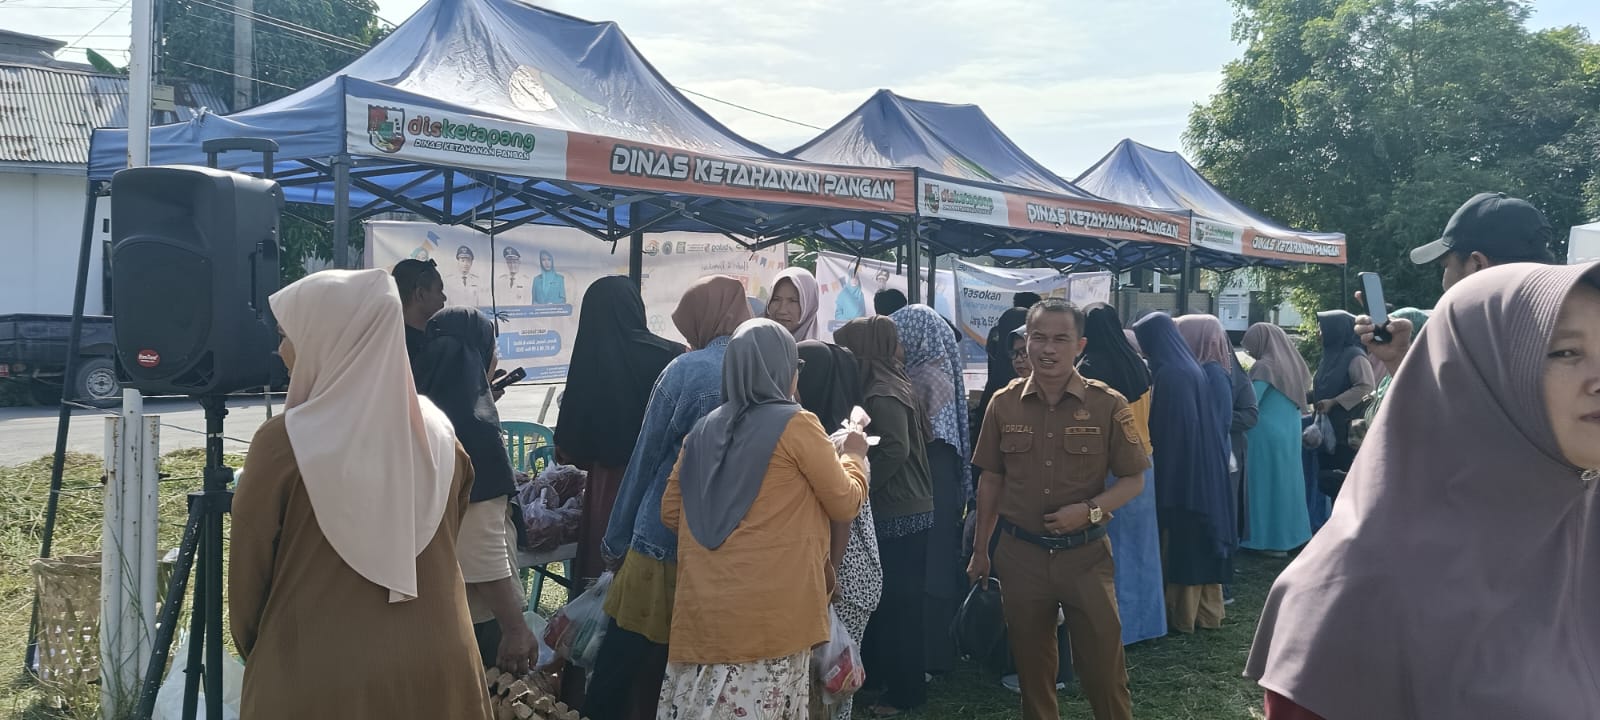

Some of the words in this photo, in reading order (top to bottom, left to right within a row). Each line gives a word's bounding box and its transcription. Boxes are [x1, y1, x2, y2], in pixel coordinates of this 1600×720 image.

[407, 115, 536, 152] disketapang
[414, 138, 443, 150] DINAS
[443, 142, 495, 156] KETAHANAN
[495, 148, 530, 160] PANGAN
[611, 145, 690, 180] DINAS
[694, 157, 821, 194] KETAHANAN
[824, 174, 896, 201] PANGAN
[1027, 203, 1066, 224] DINAS
[1069, 208, 1138, 231] KETAHANAN
[1139, 217, 1179, 239] PANGAN
[963, 287, 1001, 301] Pasokan
